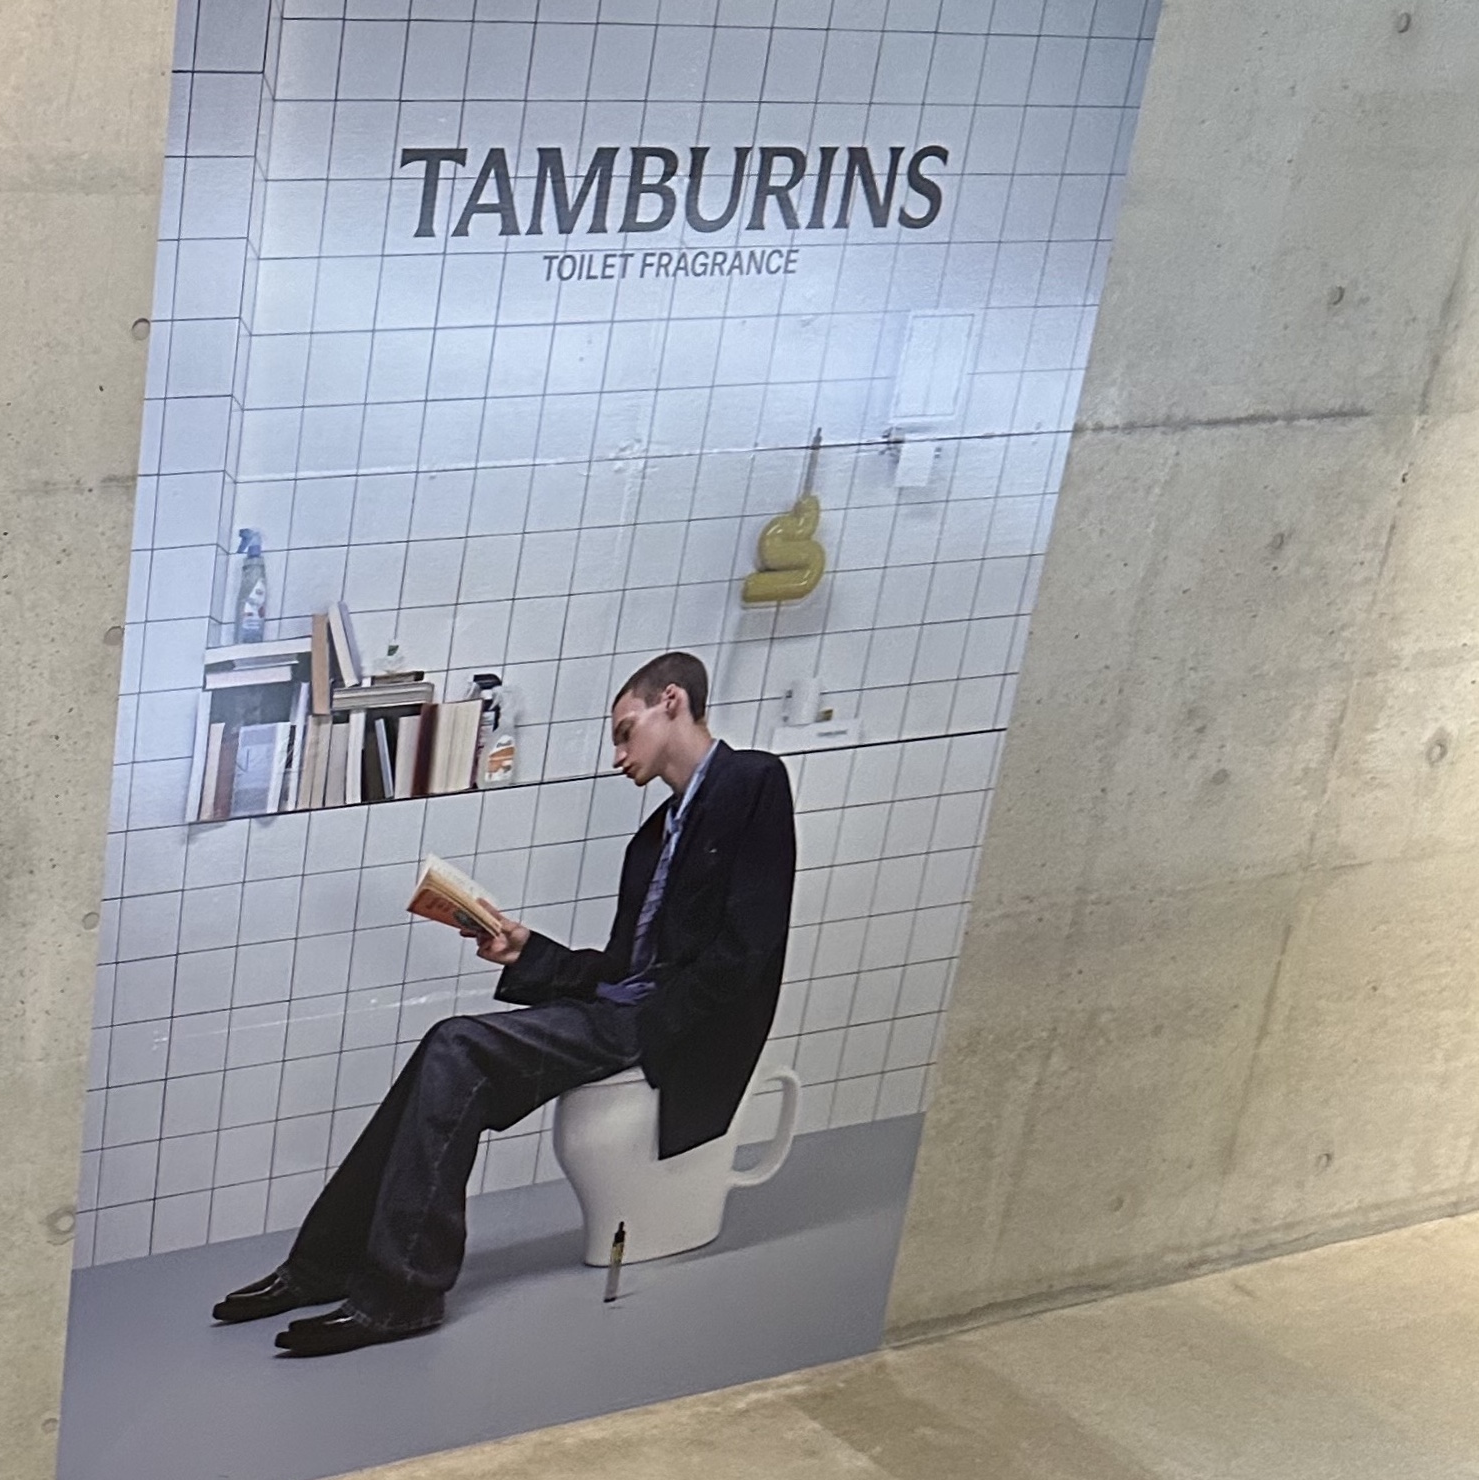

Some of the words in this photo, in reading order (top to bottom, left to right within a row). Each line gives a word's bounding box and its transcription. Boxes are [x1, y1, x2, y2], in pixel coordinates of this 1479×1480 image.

[401, 146, 949, 237] TAMBURINS
[543, 253, 635, 281] TOILET
[639, 248, 800, 278] FRAGRANCE
